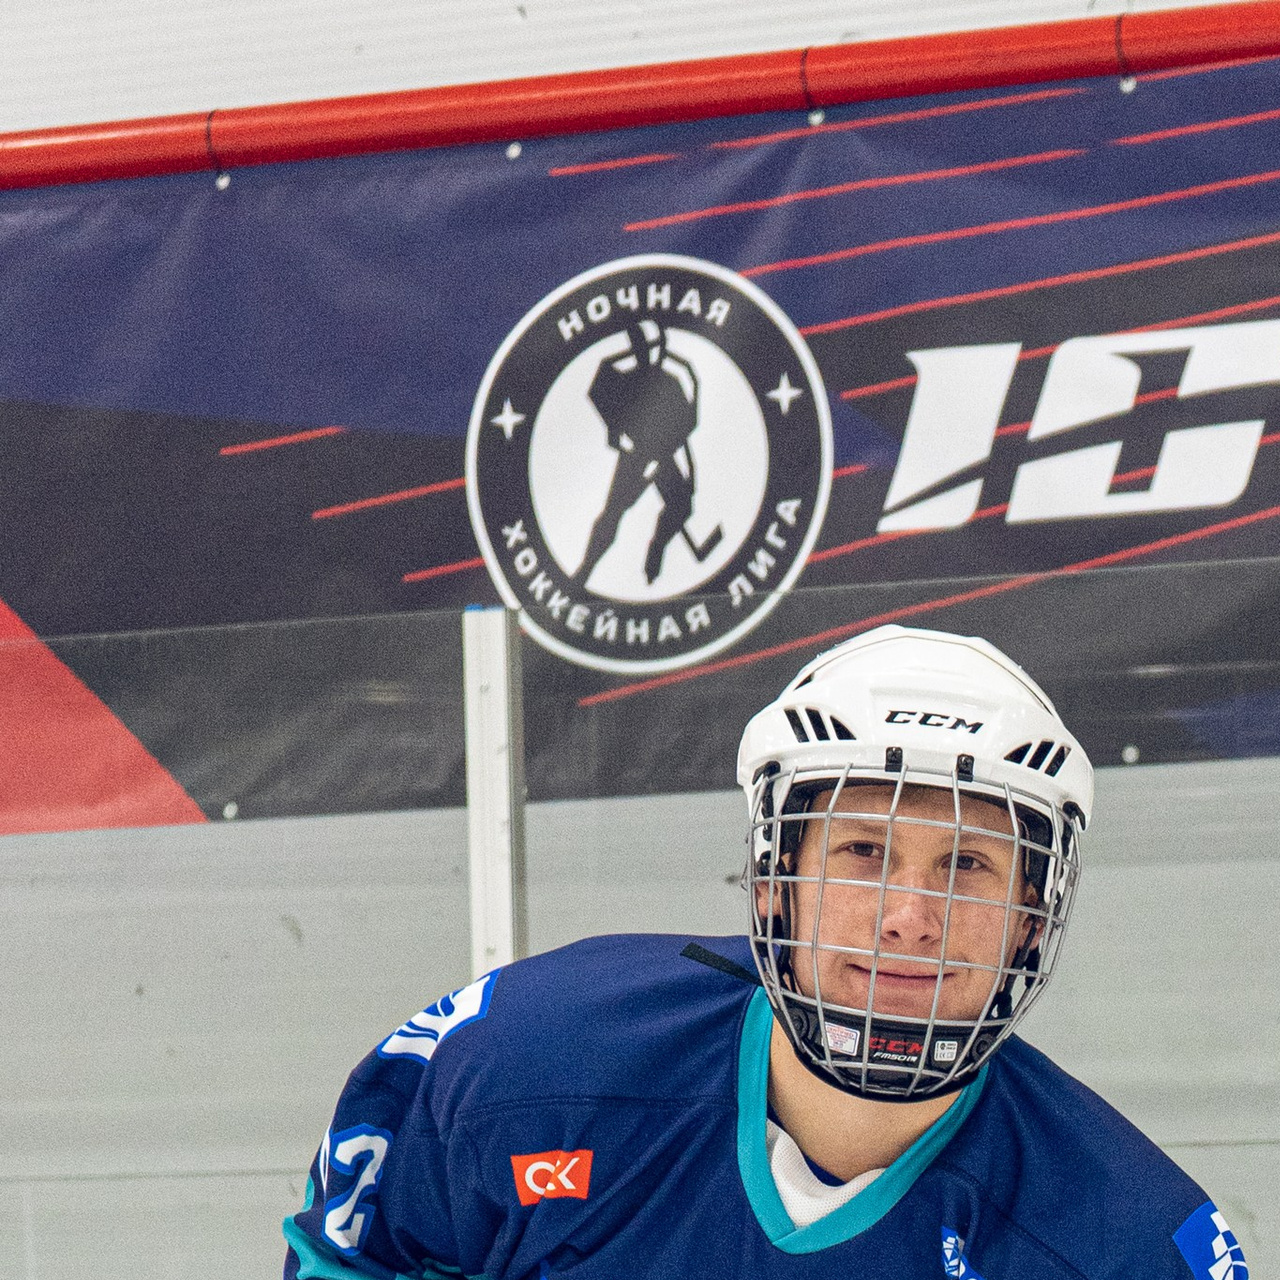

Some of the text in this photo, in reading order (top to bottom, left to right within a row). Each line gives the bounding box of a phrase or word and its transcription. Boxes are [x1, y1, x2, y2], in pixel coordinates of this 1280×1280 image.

[556, 283, 732, 342] НОЧНАЯ
[501, 498, 803, 643] ХОККЕЙНАЯ ЛИГА
[885, 709, 984, 734] CCM
[319, 1124, 392, 1255] 2
